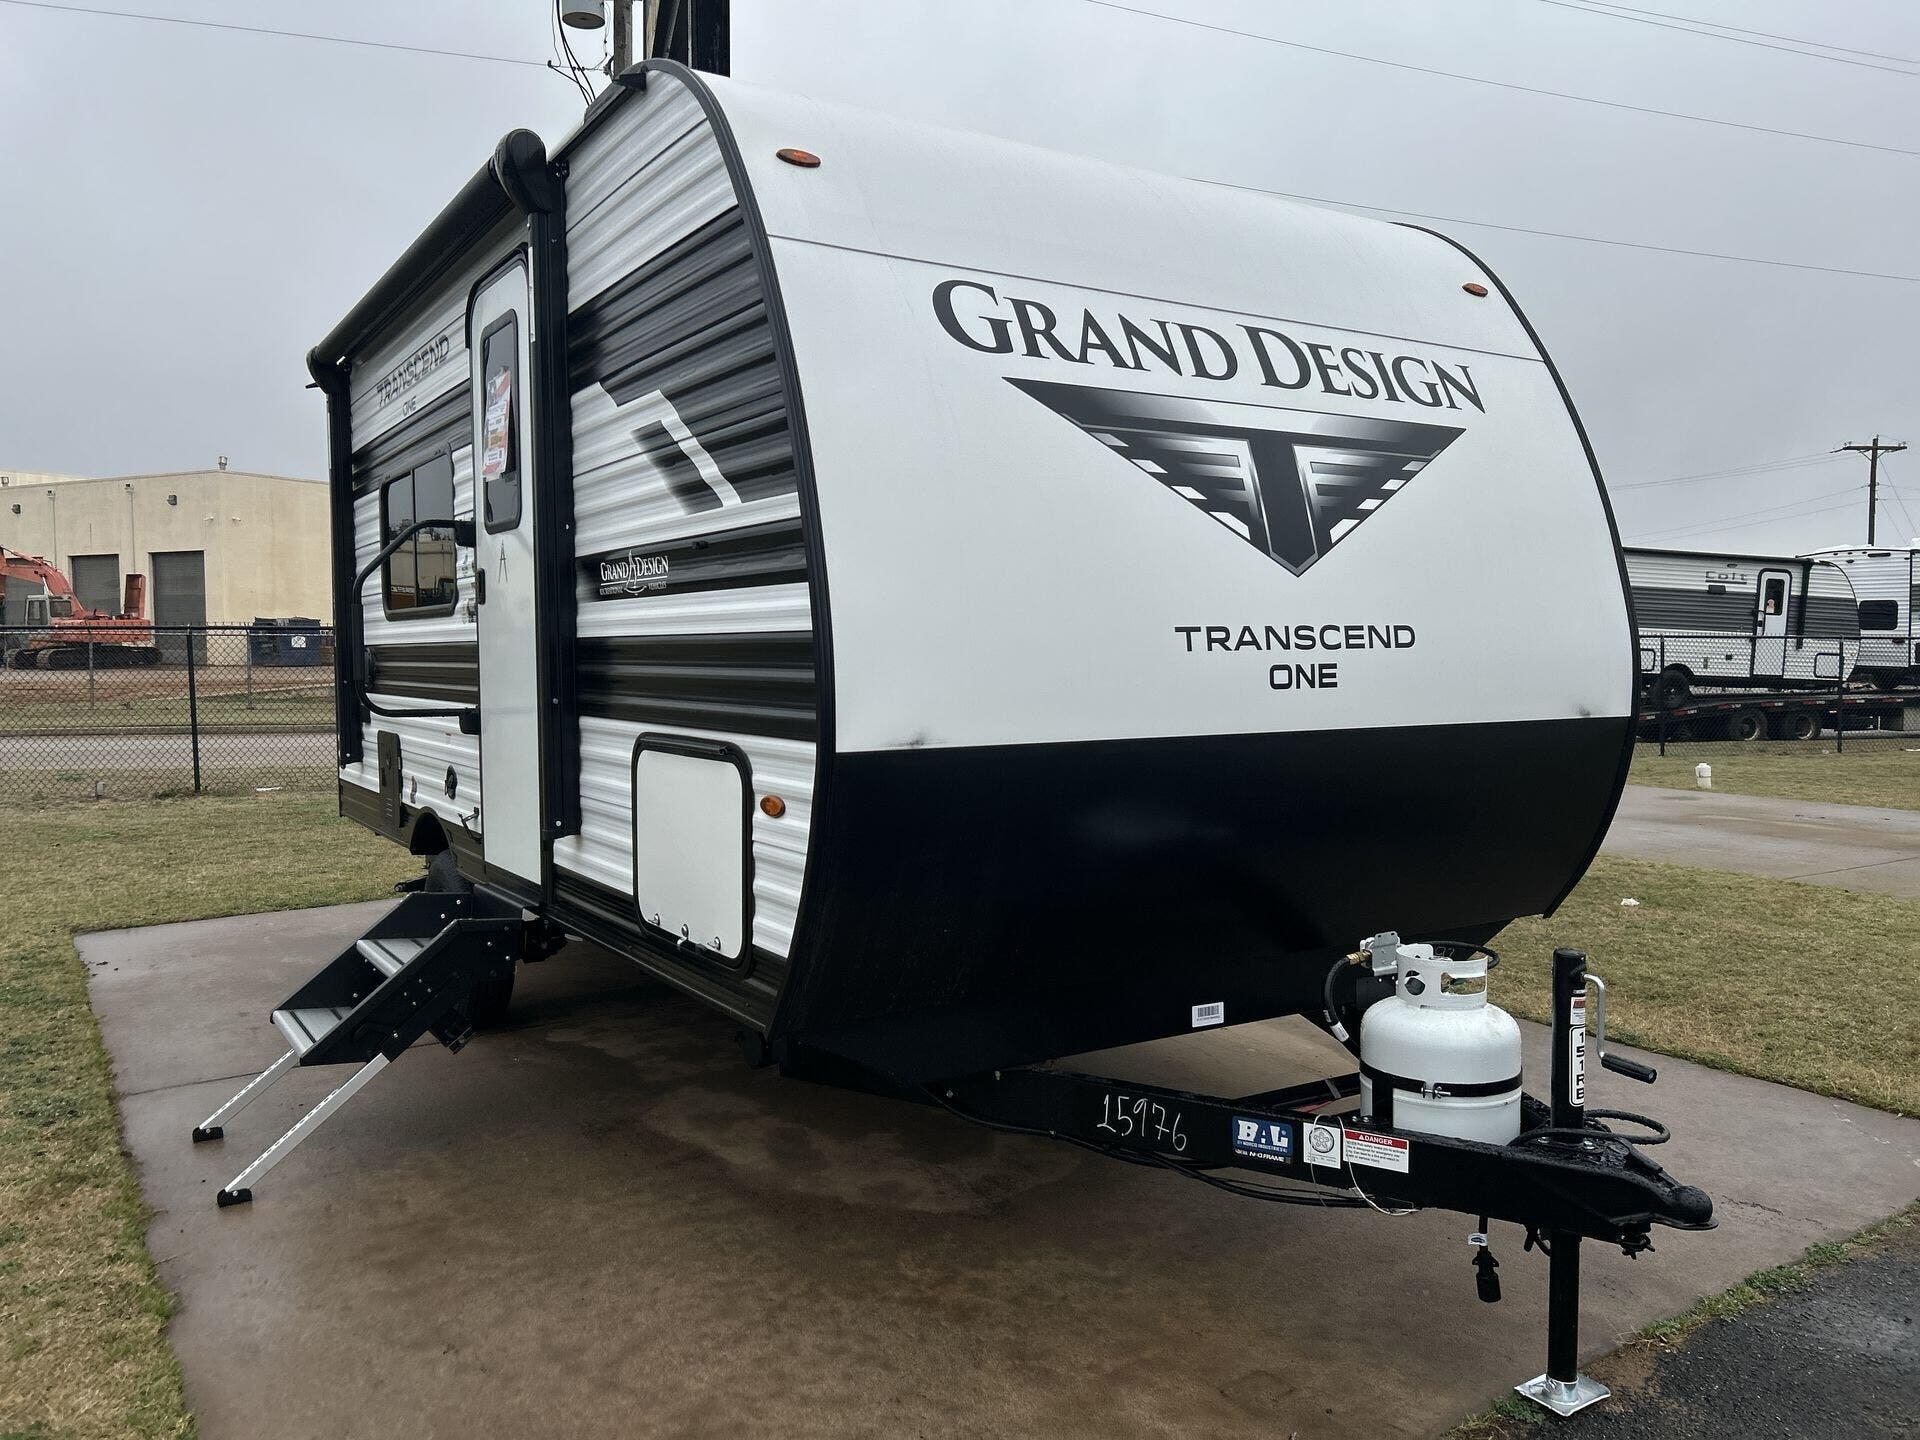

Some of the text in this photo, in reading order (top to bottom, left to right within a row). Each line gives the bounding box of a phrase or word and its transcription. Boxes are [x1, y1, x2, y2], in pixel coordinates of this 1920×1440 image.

[932, 280, 1486, 414] GRAND DESIGN
[377, 335, 449, 408] TRANSCEND
[402, 395, 417, 417] ONE
[600, 555, 669, 581] GRAND DESIGN
[1175, 625, 1416, 652] TRANSCEND
[1269, 663, 1338, 690] ONE
[1096, 1094, 1187, 1151] 15976
[1237, 1120, 1289, 1148] BAL
[1364, 1135, 1393, 1146] DANGER
